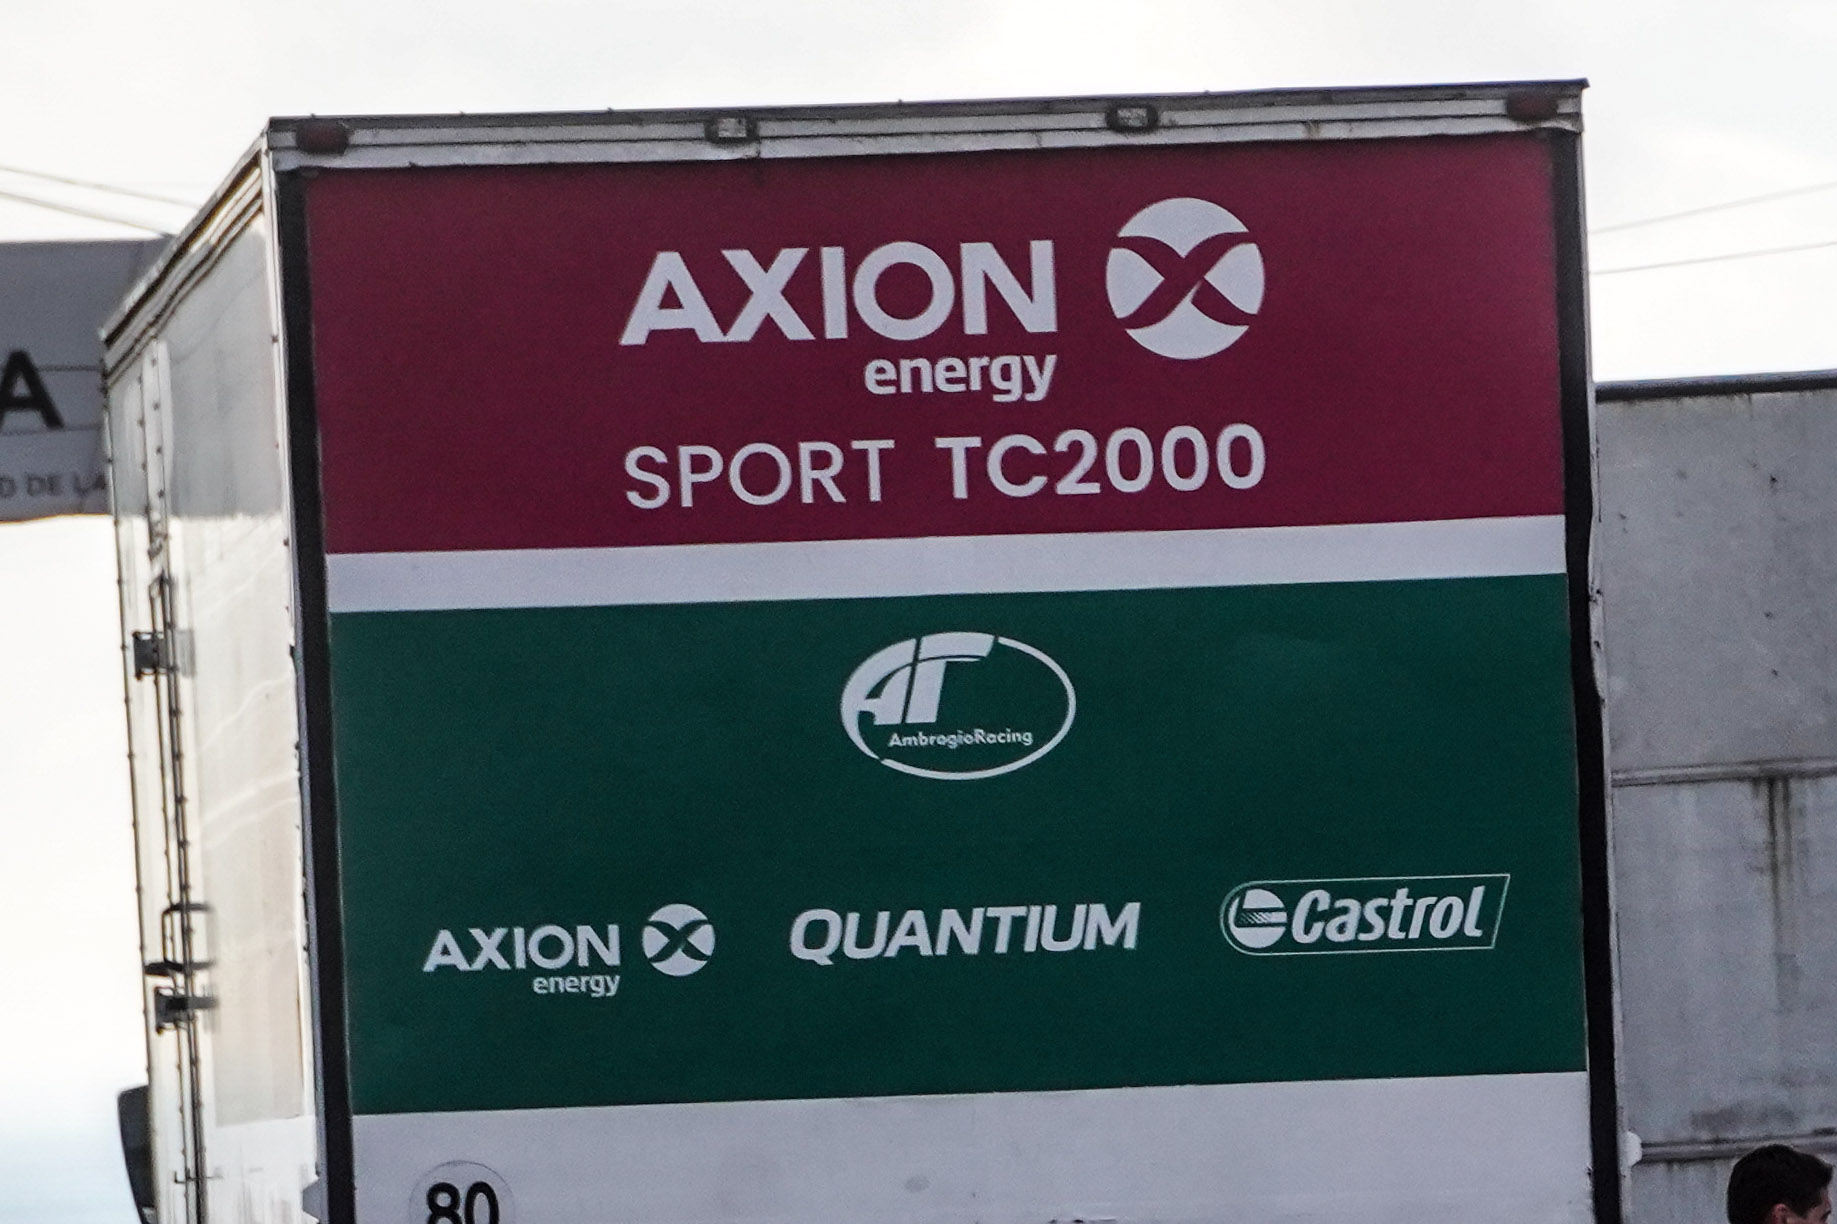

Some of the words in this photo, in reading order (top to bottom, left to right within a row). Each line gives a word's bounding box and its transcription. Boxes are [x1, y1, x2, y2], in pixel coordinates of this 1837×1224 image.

[619, 239, 1058, 346] AXION
[864, 353, 1058, 403] energy
[624, 438, 896, 510] SPORT
[934, 422, 1267, 500] TC2000
[888, 727, 1034, 749] AmbrogioRacing
[789, 902, 1141, 962] QUANTIUM
[1290, 888, 1485, 945] Castrol
[421, 923, 620, 973] AXION
[532, 971, 621, 997] energy
